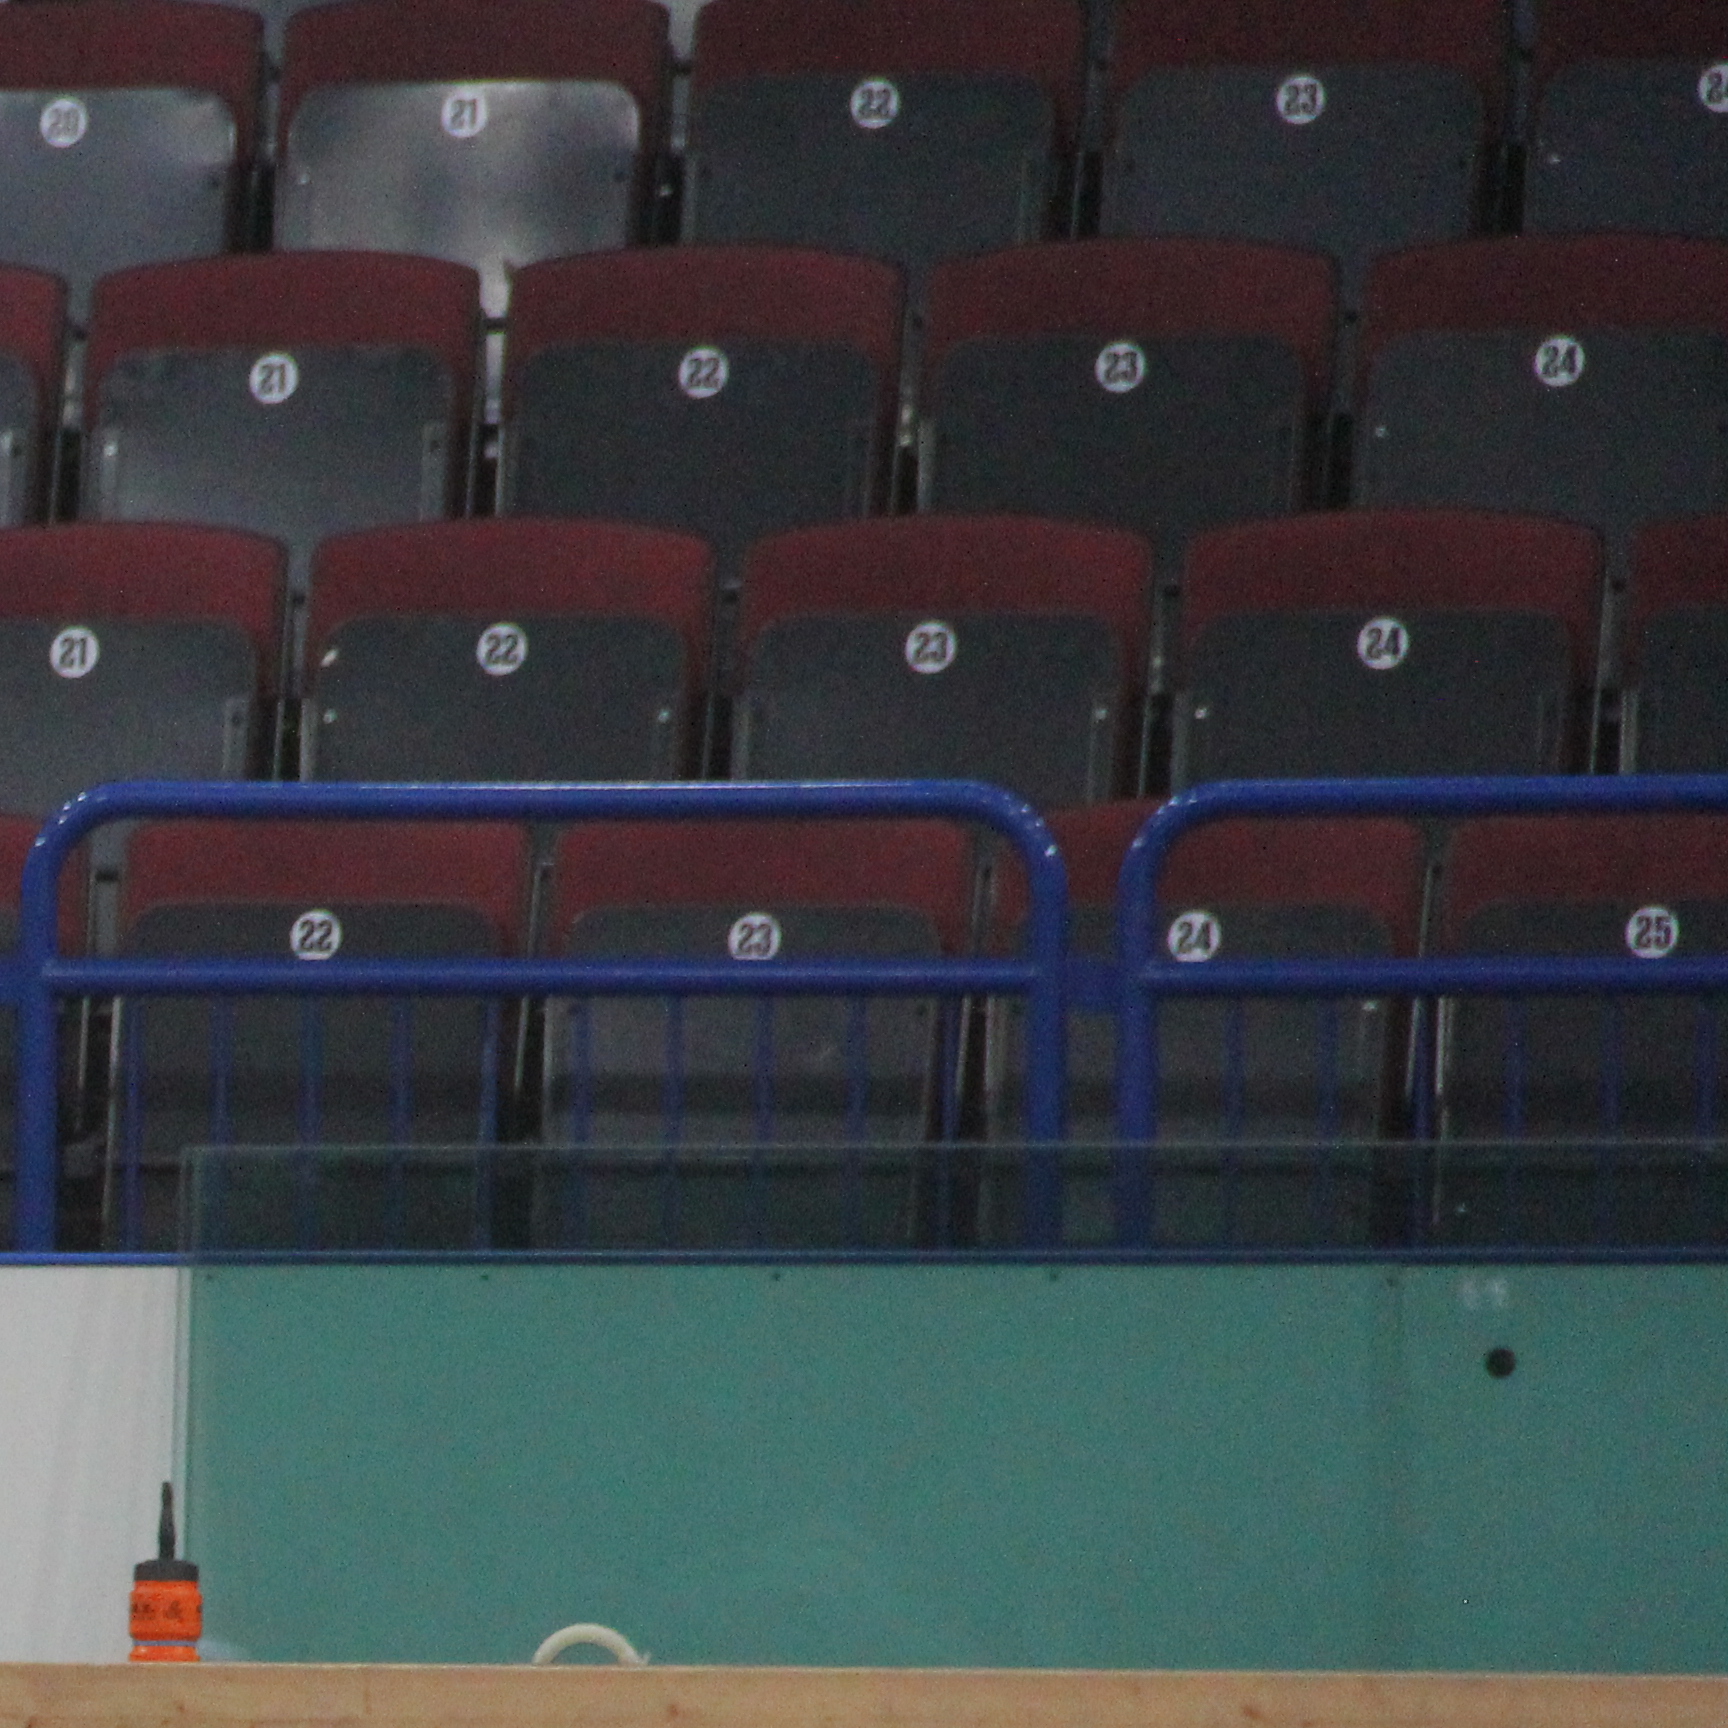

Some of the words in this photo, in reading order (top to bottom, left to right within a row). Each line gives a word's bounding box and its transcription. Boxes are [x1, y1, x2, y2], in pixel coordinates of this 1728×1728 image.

[450, 98, 478, 129] 21
[858, 88, 891, 120] 22
[1285, 84, 1318, 115] 23
[687, 357, 719, 388] 22
[1105, 352, 1138, 383] 23
[1544, 346, 1577, 376] 24
[259, 363, 286, 394] 21
[59, 637, 88, 668] 21
[486, 633, 518, 665] 22
[914, 632, 948, 663] 23
[1367, 627, 1400, 658] 24
[300, 919, 333, 952] 22
[738, 923, 772, 956] 23
[1178, 921, 1211, 952] 24
[1636, 916, 1670, 949] 25
